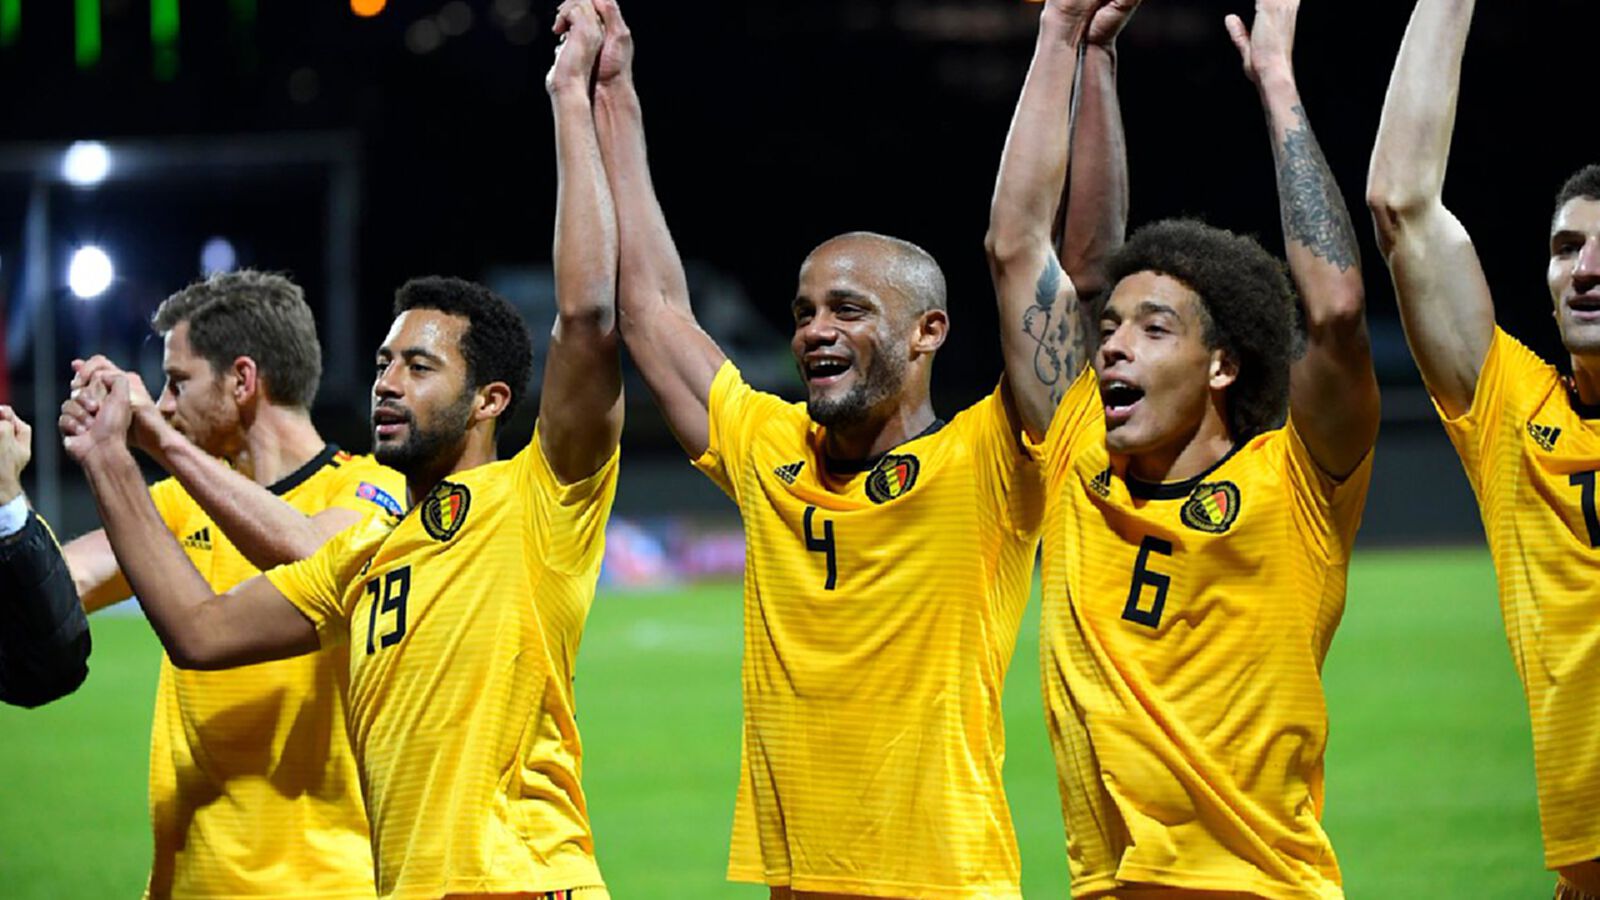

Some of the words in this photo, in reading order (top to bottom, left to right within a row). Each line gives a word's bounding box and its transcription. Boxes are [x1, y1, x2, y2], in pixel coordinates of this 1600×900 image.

[803, 506, 837, 590] 4
[1121, 534, 1172, 629] 6
[366, 565, 411, 655] 19
